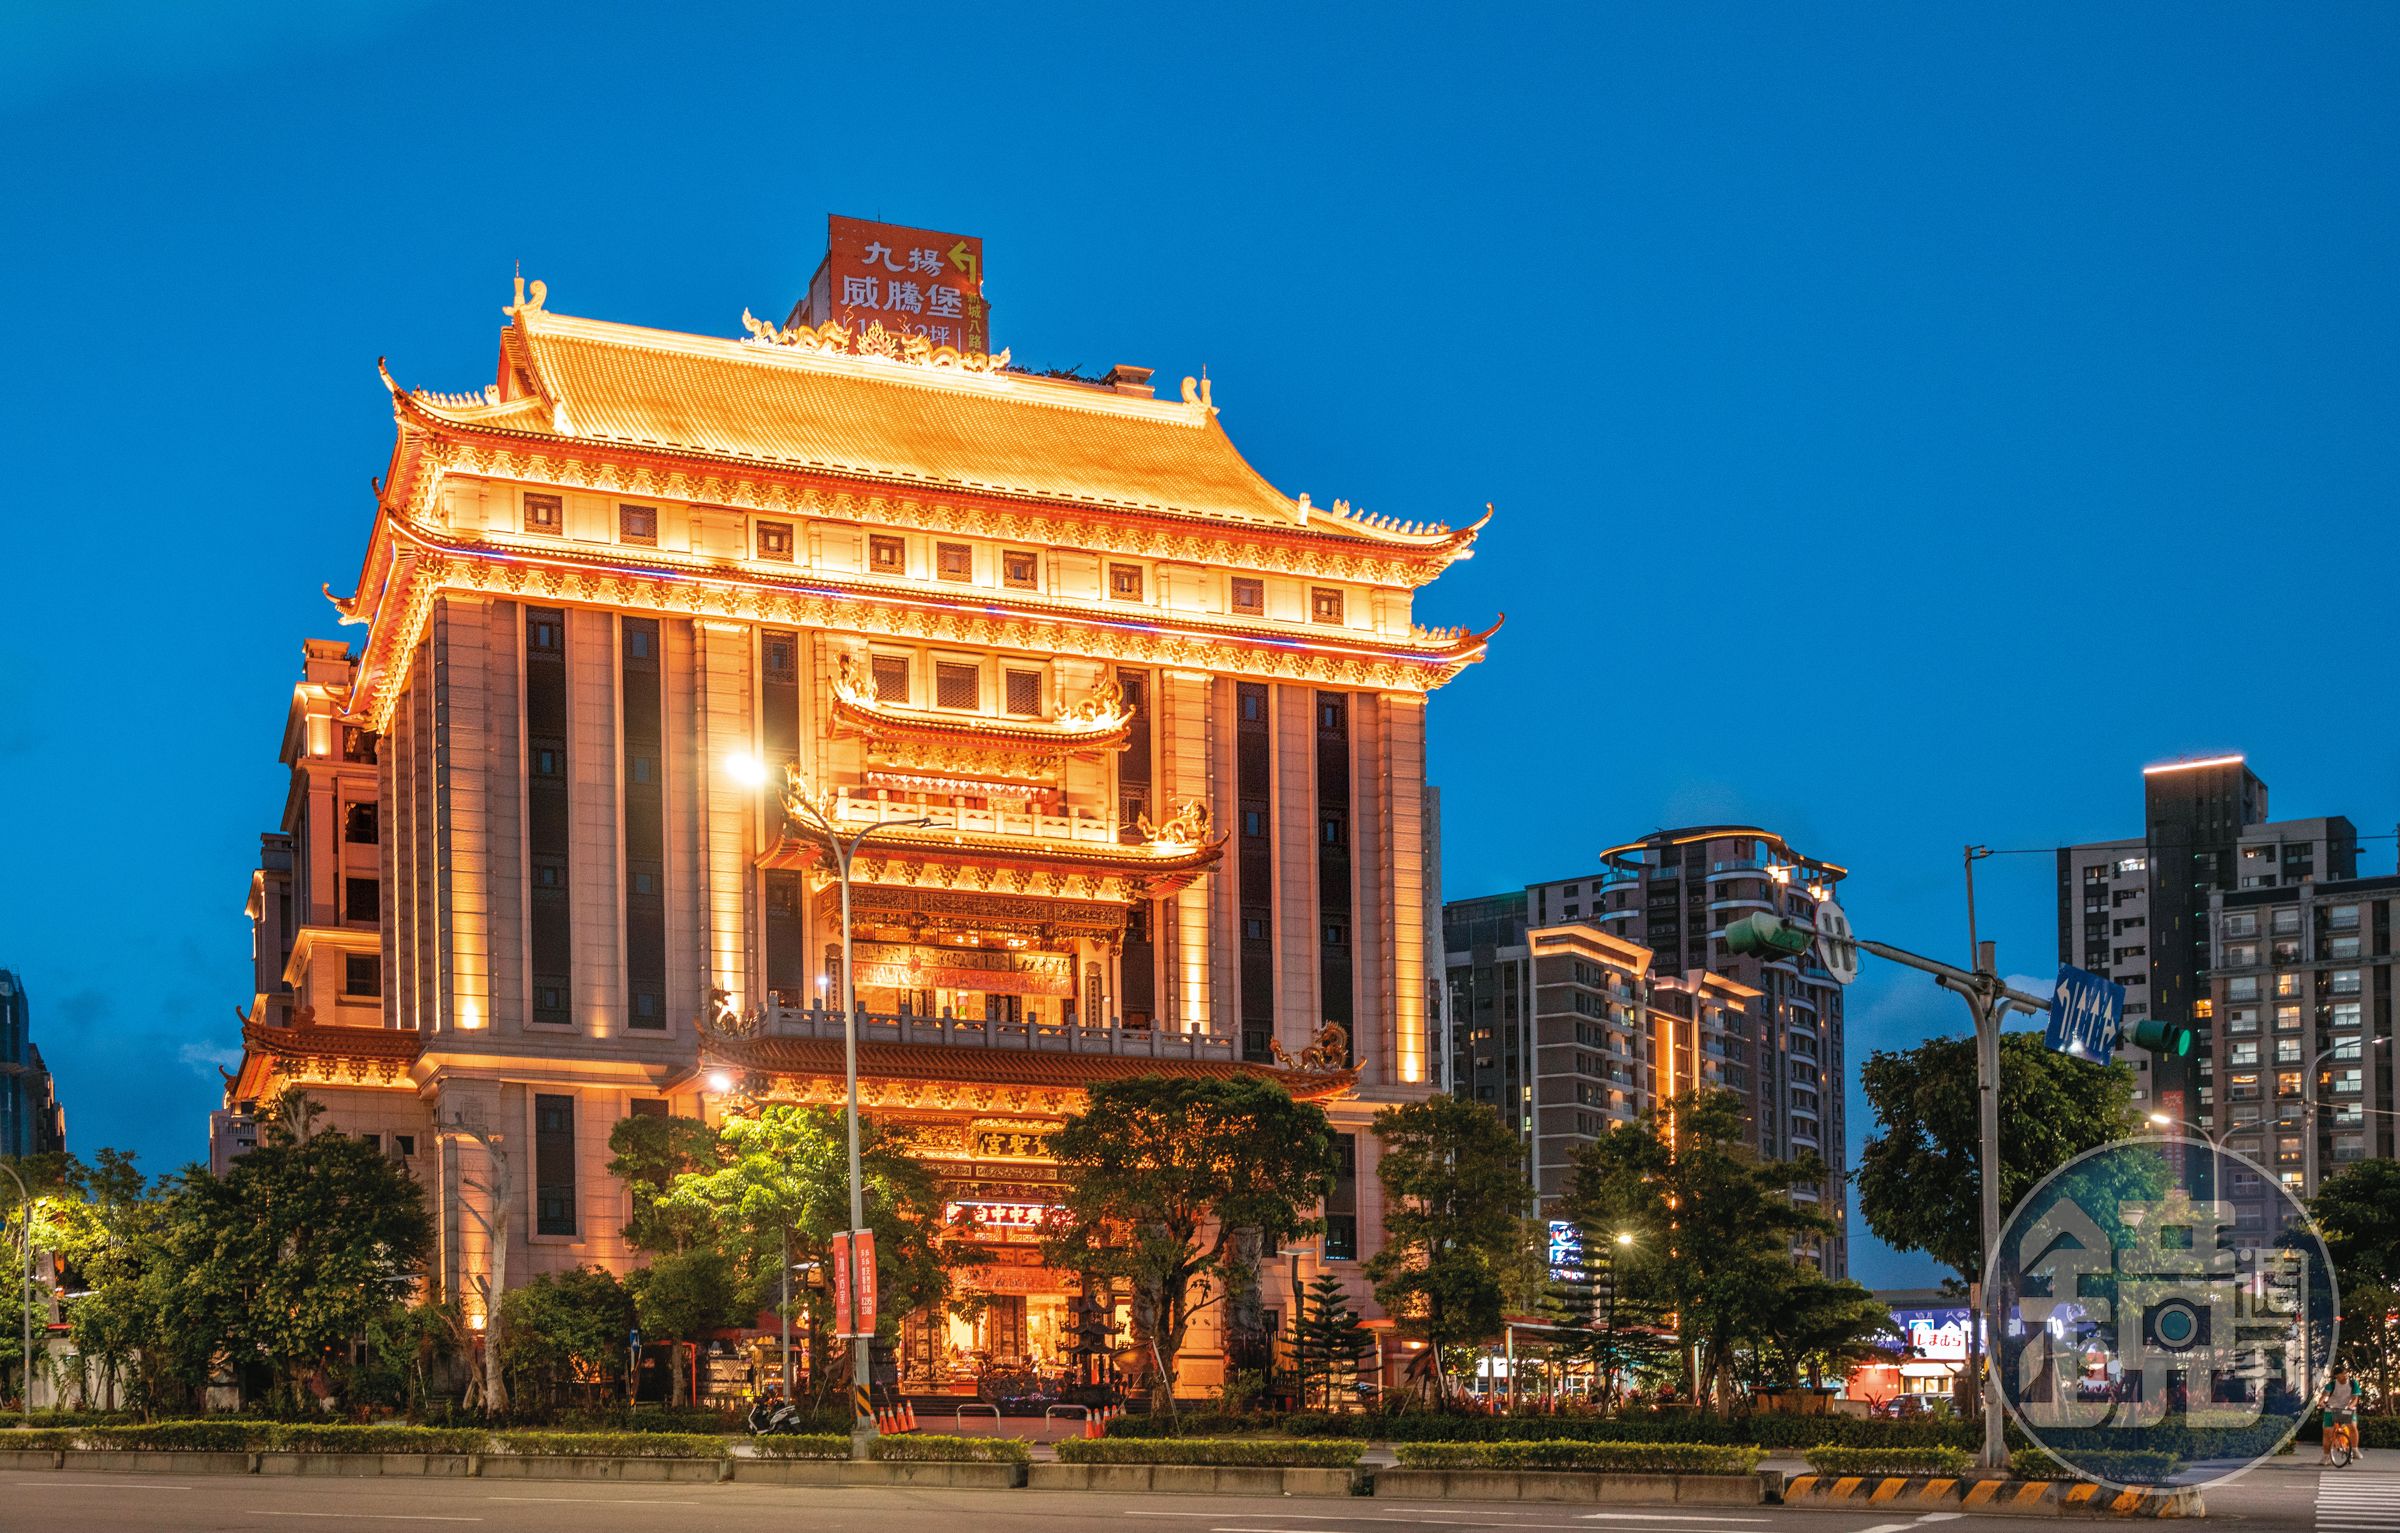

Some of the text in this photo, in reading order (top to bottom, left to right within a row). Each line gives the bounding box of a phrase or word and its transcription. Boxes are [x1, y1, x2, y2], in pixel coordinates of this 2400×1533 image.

[862, 241, 945, 278] 九揚
[840, 274, 963, 319] 威騰堡
[967, 290, 982, 356] 新城八路
[1916, 1333, 1963, 1347] しまむら
